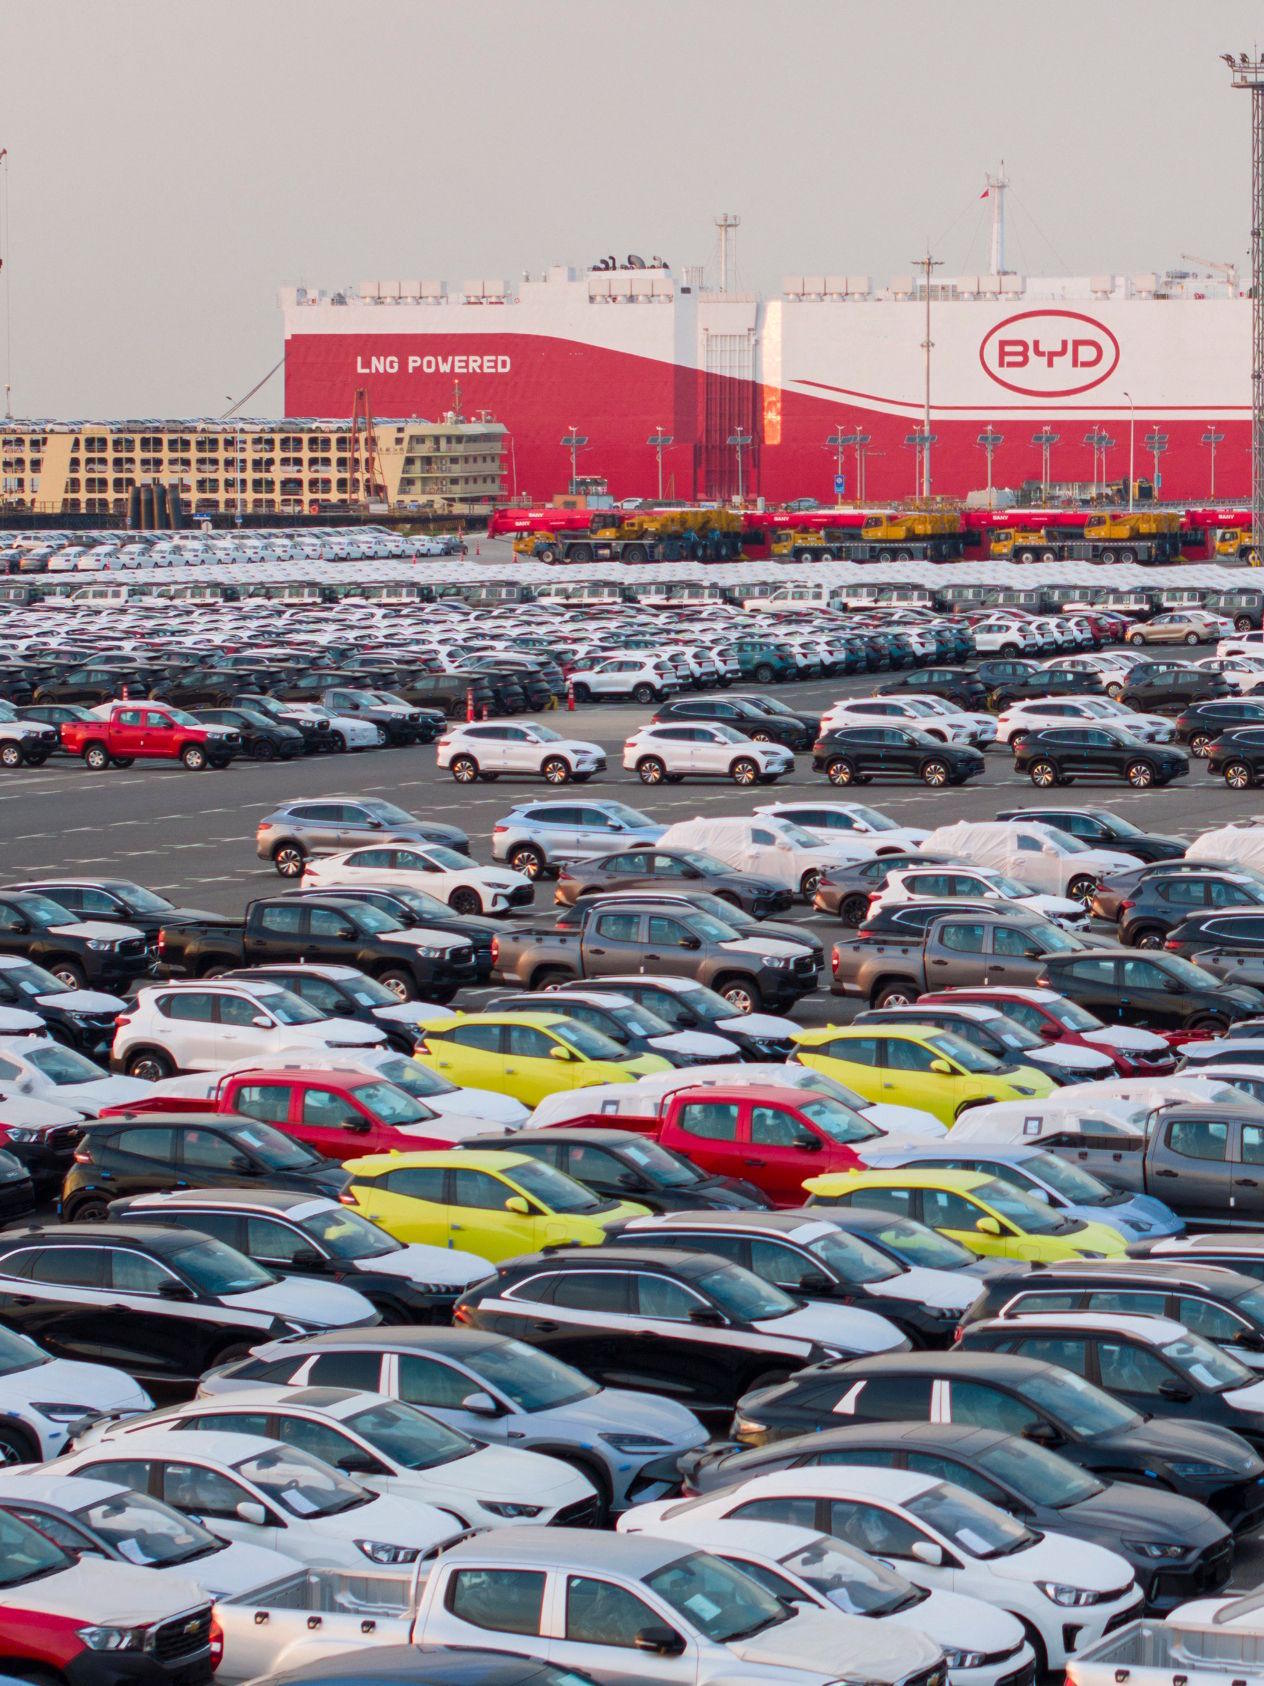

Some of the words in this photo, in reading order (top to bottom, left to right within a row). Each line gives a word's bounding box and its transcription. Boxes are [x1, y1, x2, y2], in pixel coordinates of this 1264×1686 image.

[356, 356, 399, 373] LNG
[408, 355, 511, 373] POWERED
[998, 339, 1103, 368] BYD
